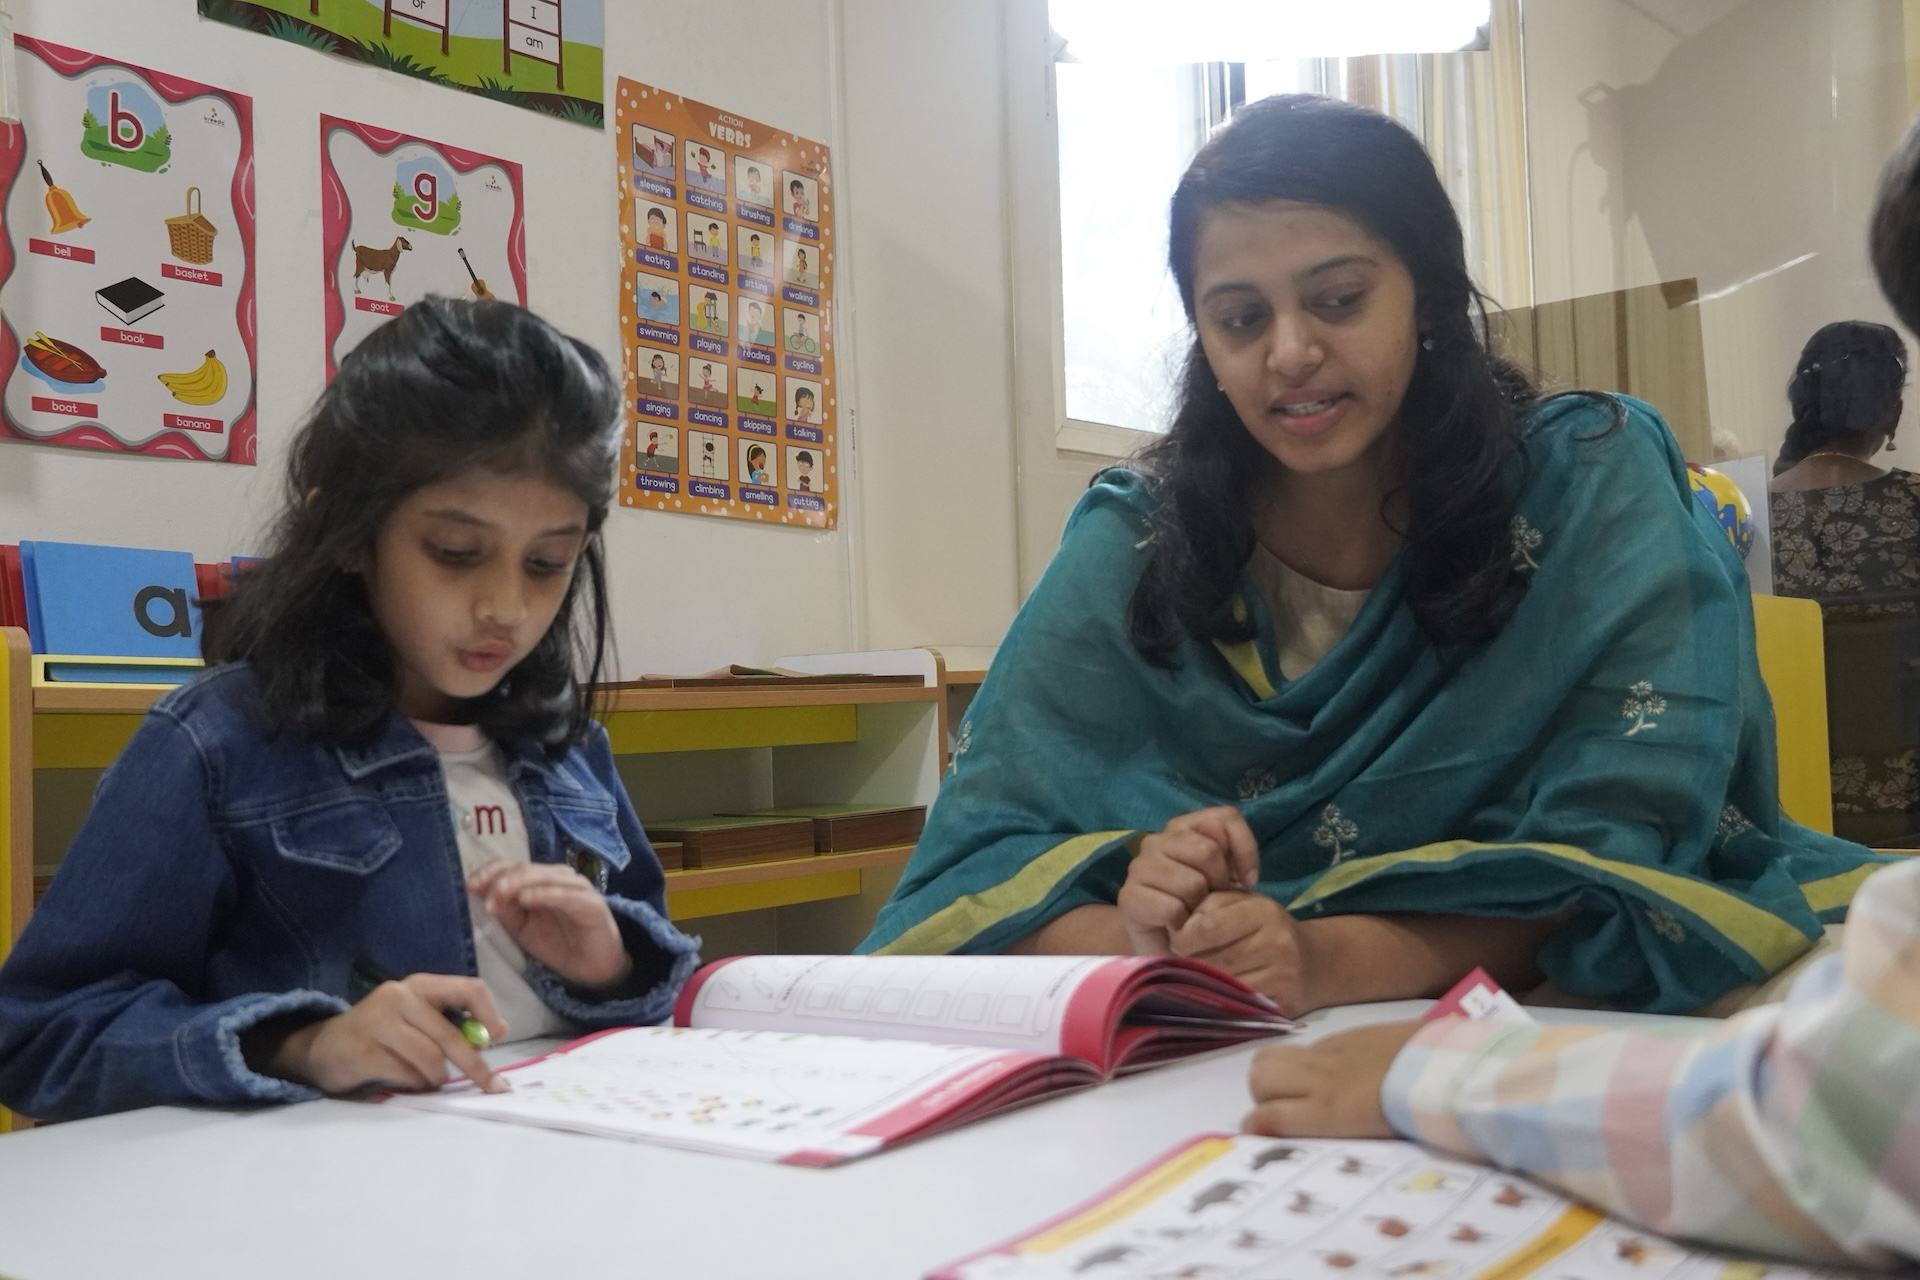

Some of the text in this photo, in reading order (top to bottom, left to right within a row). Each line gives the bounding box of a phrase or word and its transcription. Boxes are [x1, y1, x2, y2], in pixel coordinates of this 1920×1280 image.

[531, 6, 536, 19] I
[526, 37, 543, 49] am
[111, 91, 143, 149] b
[718, 114, 744, 128] ACTION
[708, 121, 751, 148] VERBS
[639, 179, 671, 197] sleeping
[412, 172, 437, 221] g
[690, 194, 723, 211] catching
[740, 207, 771, 225] brushing
[788, 221, 814, 237] drinking
[54, 245, 71, 257] bell
[645, 253, 671, 269] eating
[175, 267, 208, 281] basket
[691, 265, 725, 282] standing
[744, 278, 768, 293] sitting
[788, 290, 814, 305] walking
[370, 303, 390, 312] goat
[120, 331, 145, 344] book
[639, 327, 678, 344] swimming
[696, 337, 722, 353] playing
[742, 349, 771, 363] reading
[792, 359, 815, 373] cycling
[52, 402, 78, 414] boat
[645, 403, 672, 417] singing
[176, 418, 211, 430] banana
[694, 411, 723, 426] dancing
[743, 419, 772, 434] skipping
[793, 427, 816, 441] talking
[640, 477, 676, 492] throwing
[694, 483, 725, 498] climbing
[745, 490, 774, 504] smelling
[793, 497, 819, 510] cutting
[133, 585, 192, 638] a
[474, 805, 507, 835] m
